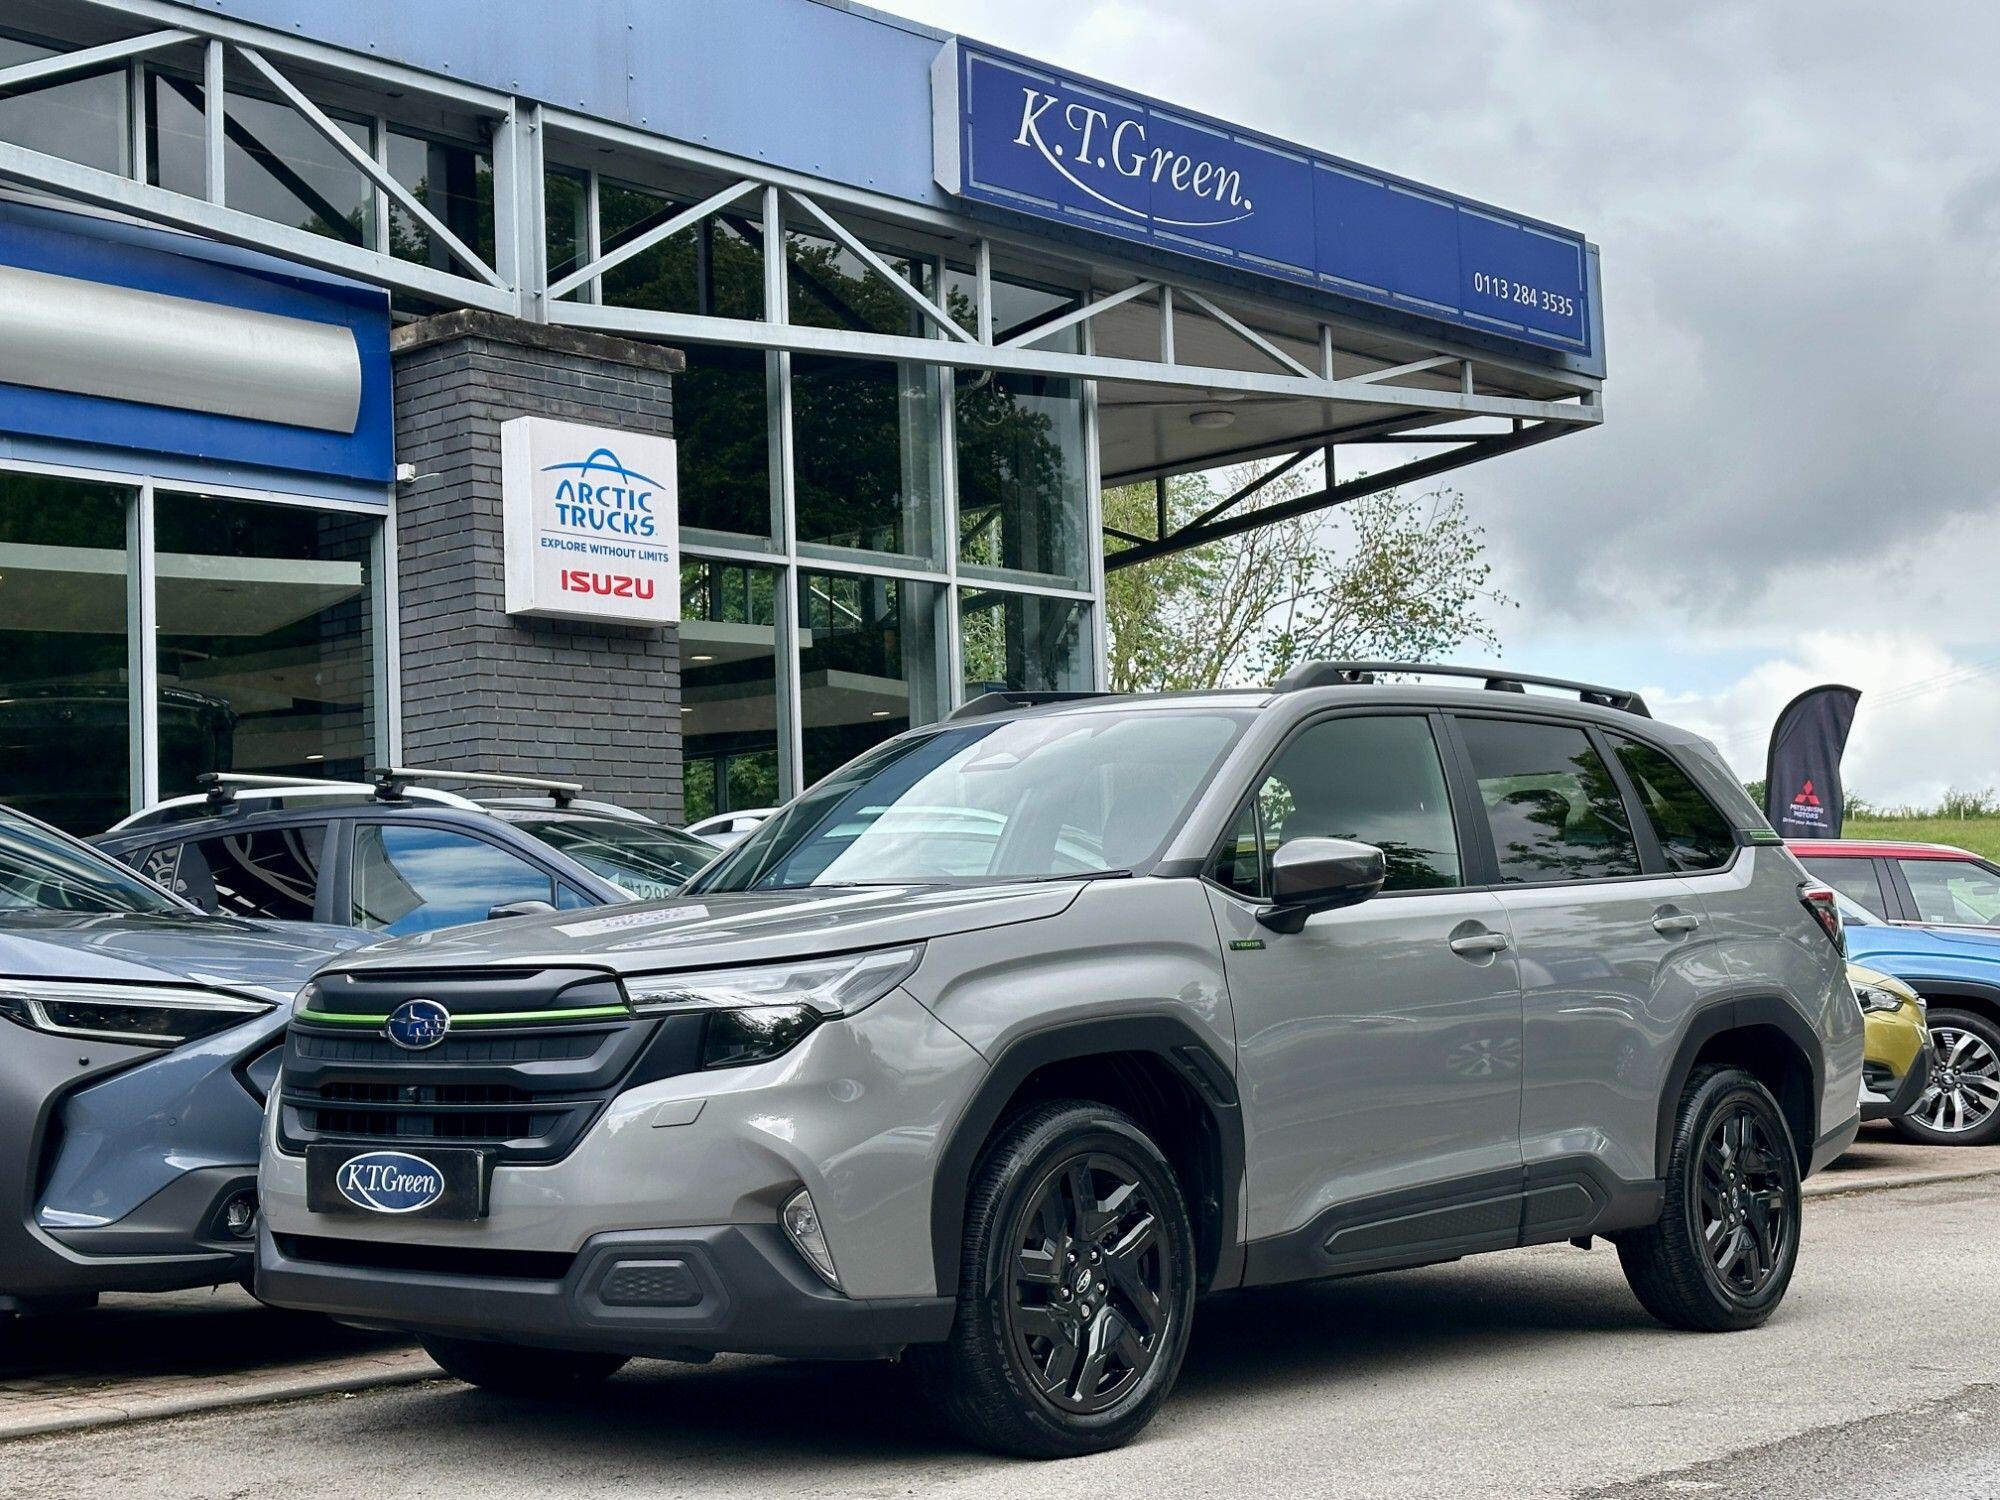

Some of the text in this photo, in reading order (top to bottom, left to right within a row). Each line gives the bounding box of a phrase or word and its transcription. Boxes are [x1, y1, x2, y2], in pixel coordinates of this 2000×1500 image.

[1474, 271, 1573, 317] 0113 284 3535
[555, 479, 652, 513] ARCTIC
[555, 503, 655, 537] TRUCKS
[541, 537, 669, 563] EXPLORE WITHOUT LIMITS
[561, 569, 654, 600] ISUZU
[1794, 811, 1818, 819] MOTORS
